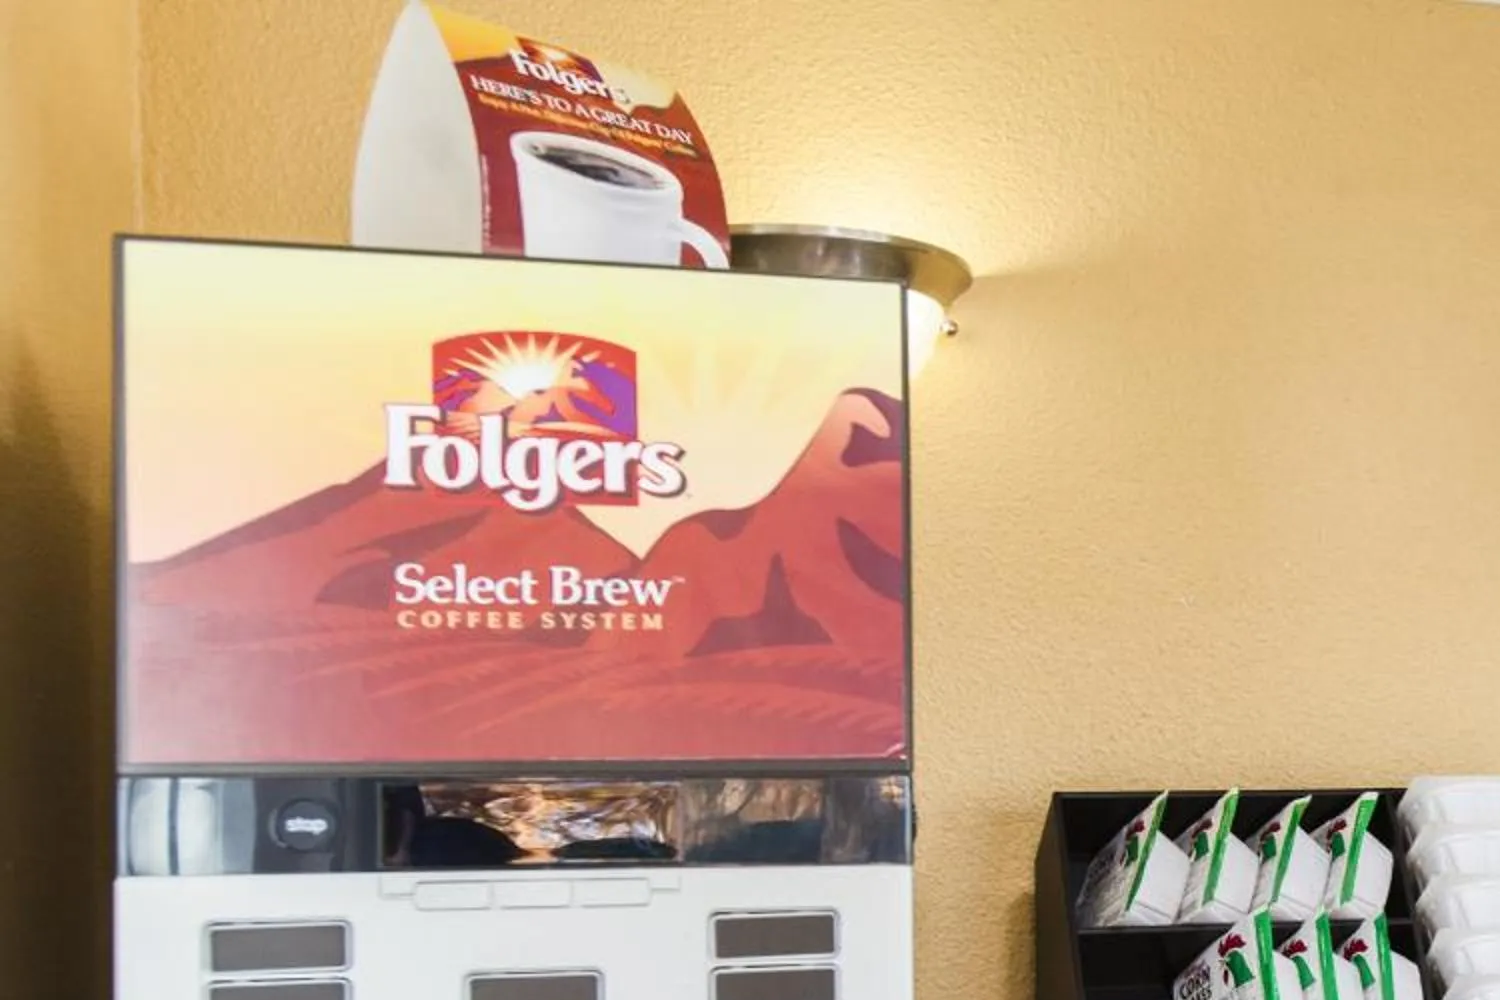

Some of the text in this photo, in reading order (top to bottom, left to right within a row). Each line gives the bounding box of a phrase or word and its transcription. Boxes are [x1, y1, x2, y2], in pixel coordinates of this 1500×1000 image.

[510, 48, 632, 104] Folgers
[470, 75, 694, 145] HERE'S TO A GREAT DAY
[383, 402, 688, 512] Folgers
[394, 562, 539, 605] Select
[396, 609, 664, 631] COFFEE SYSTEM
[1180, 967, 1211, 1000] CORN
